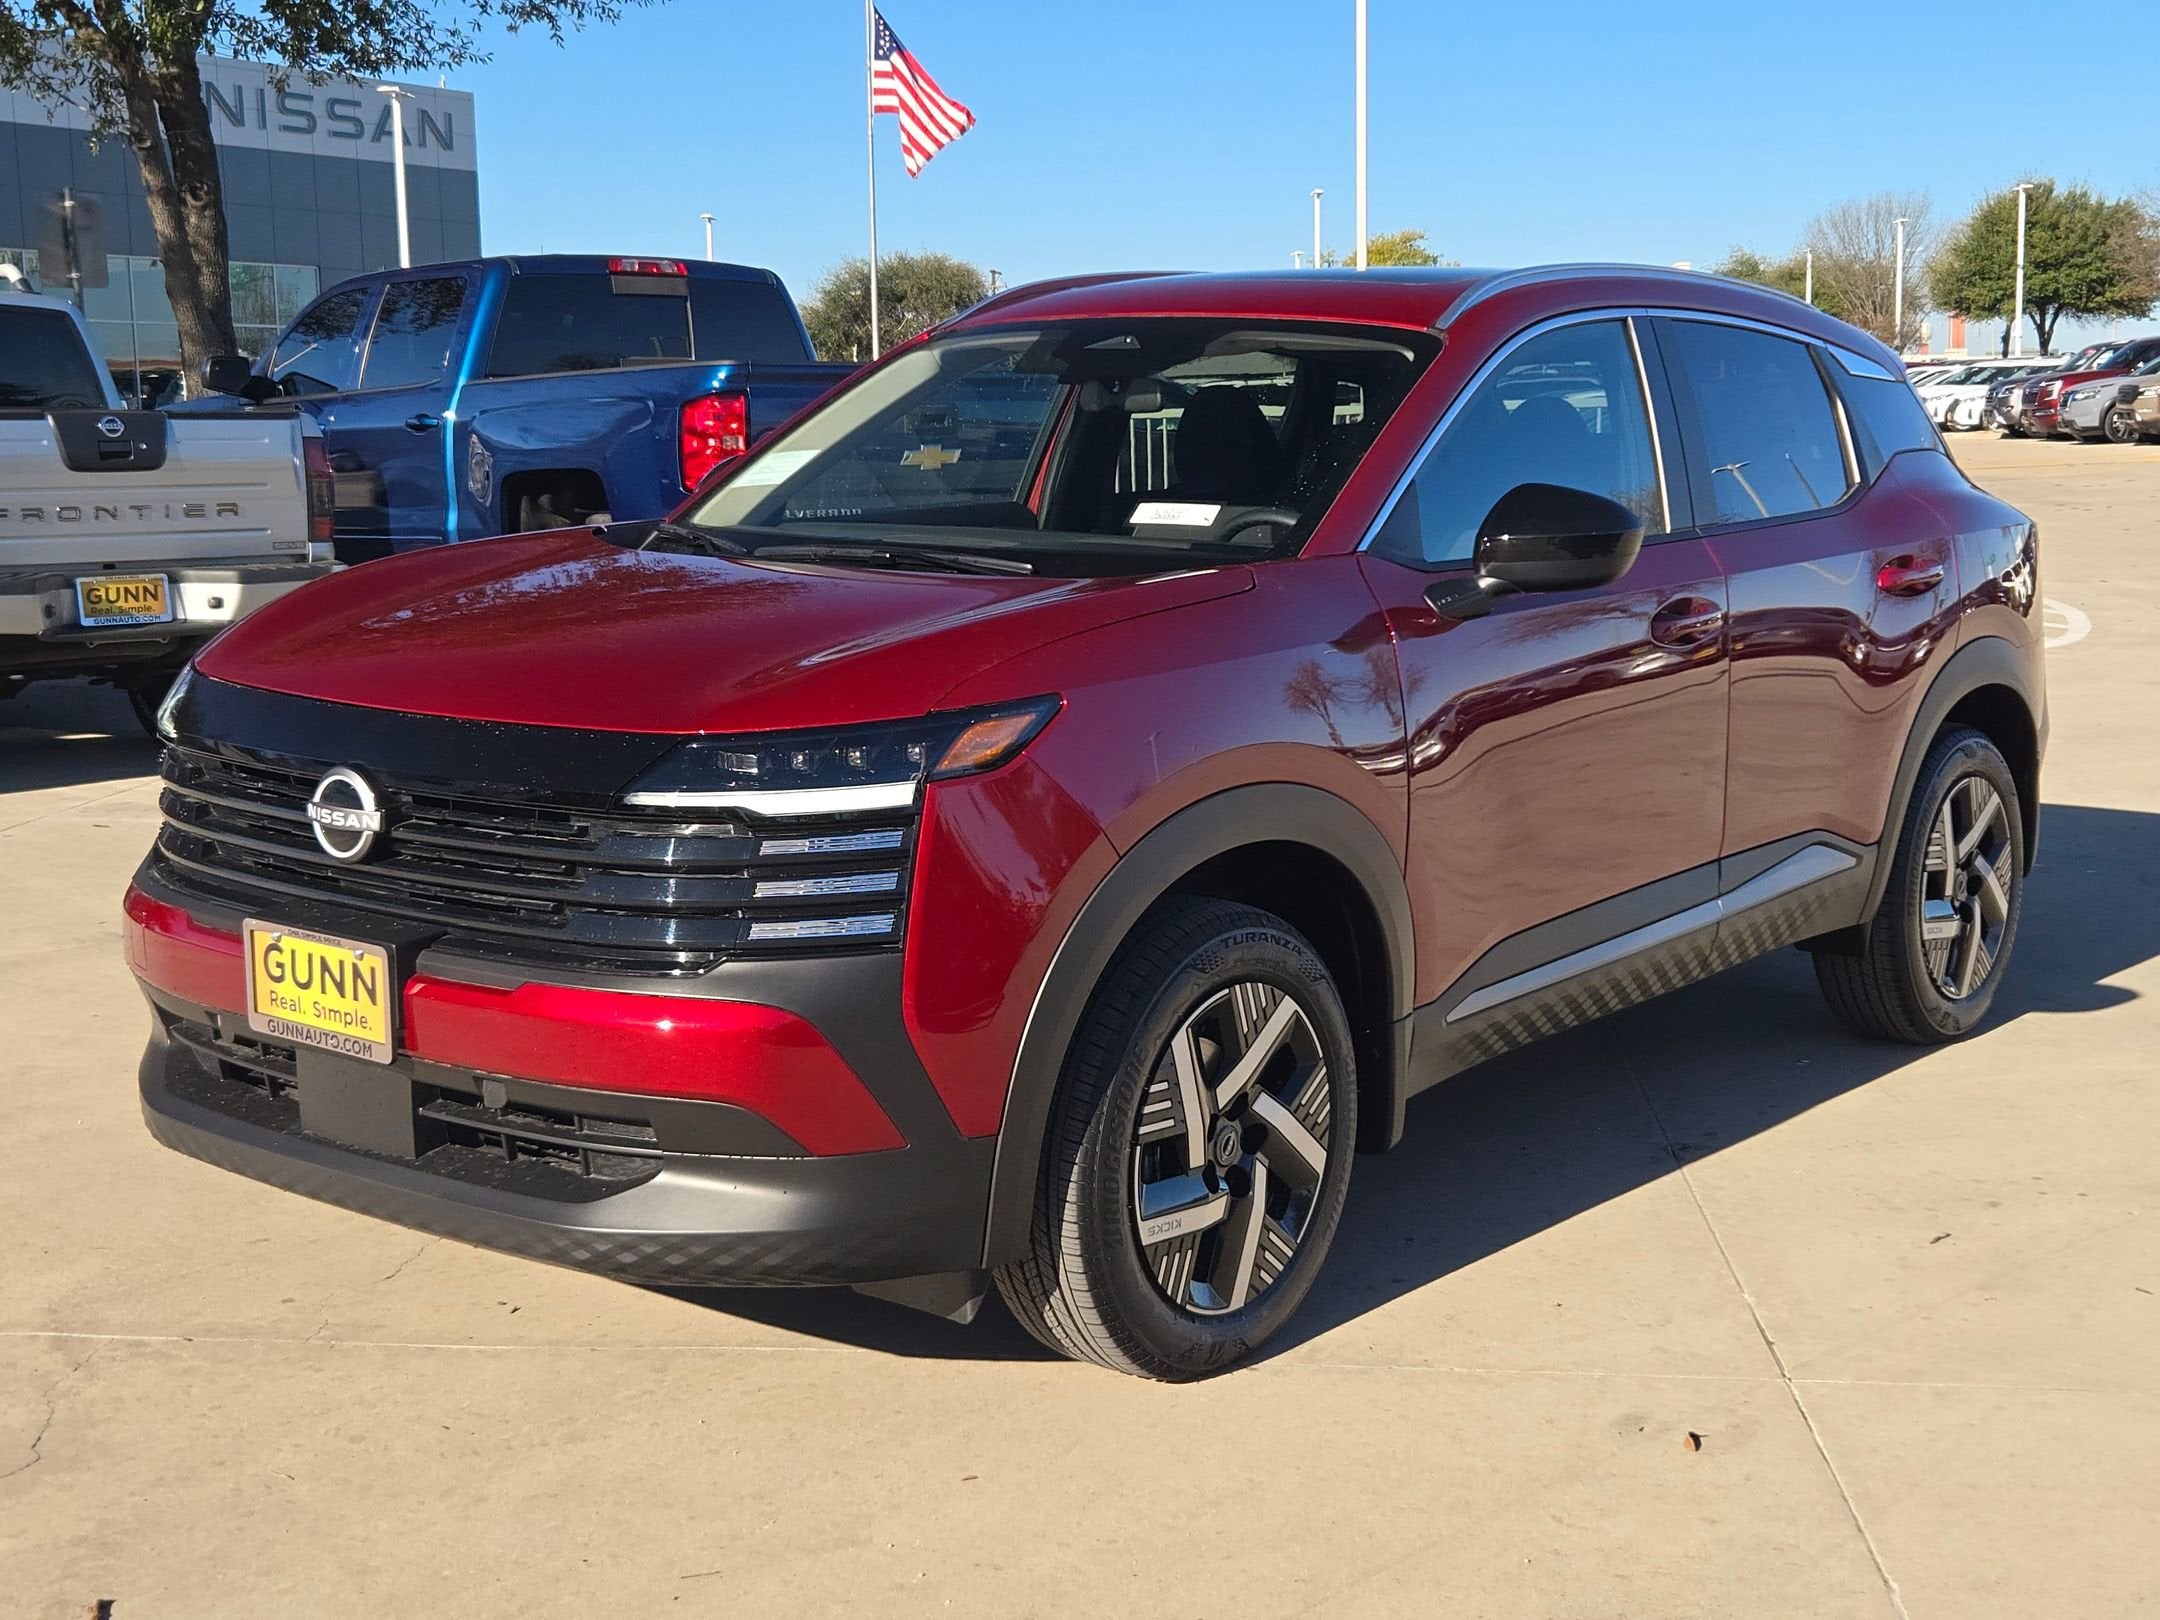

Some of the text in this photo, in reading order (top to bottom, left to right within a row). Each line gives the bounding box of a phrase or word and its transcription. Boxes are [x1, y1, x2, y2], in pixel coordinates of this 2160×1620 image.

[203, 80, 454, 151] NISSAN
[85, 584, 160, 605] GUNN
[91, 606, 116, 615] Real.
[94, 614, 161, 625] GUNNAUTO.COM
[307, 802, 378, 829] NISSAN
[1221, 931, 1302, 956] TURANZA
[263, 942, 377, 1006] GUNN
[270, 990, 307, 1015] Real.
[267, 1019, 373, 1058] GUNNAUTO.COM
[1148, 1218, 1182, 1236] KICKS
